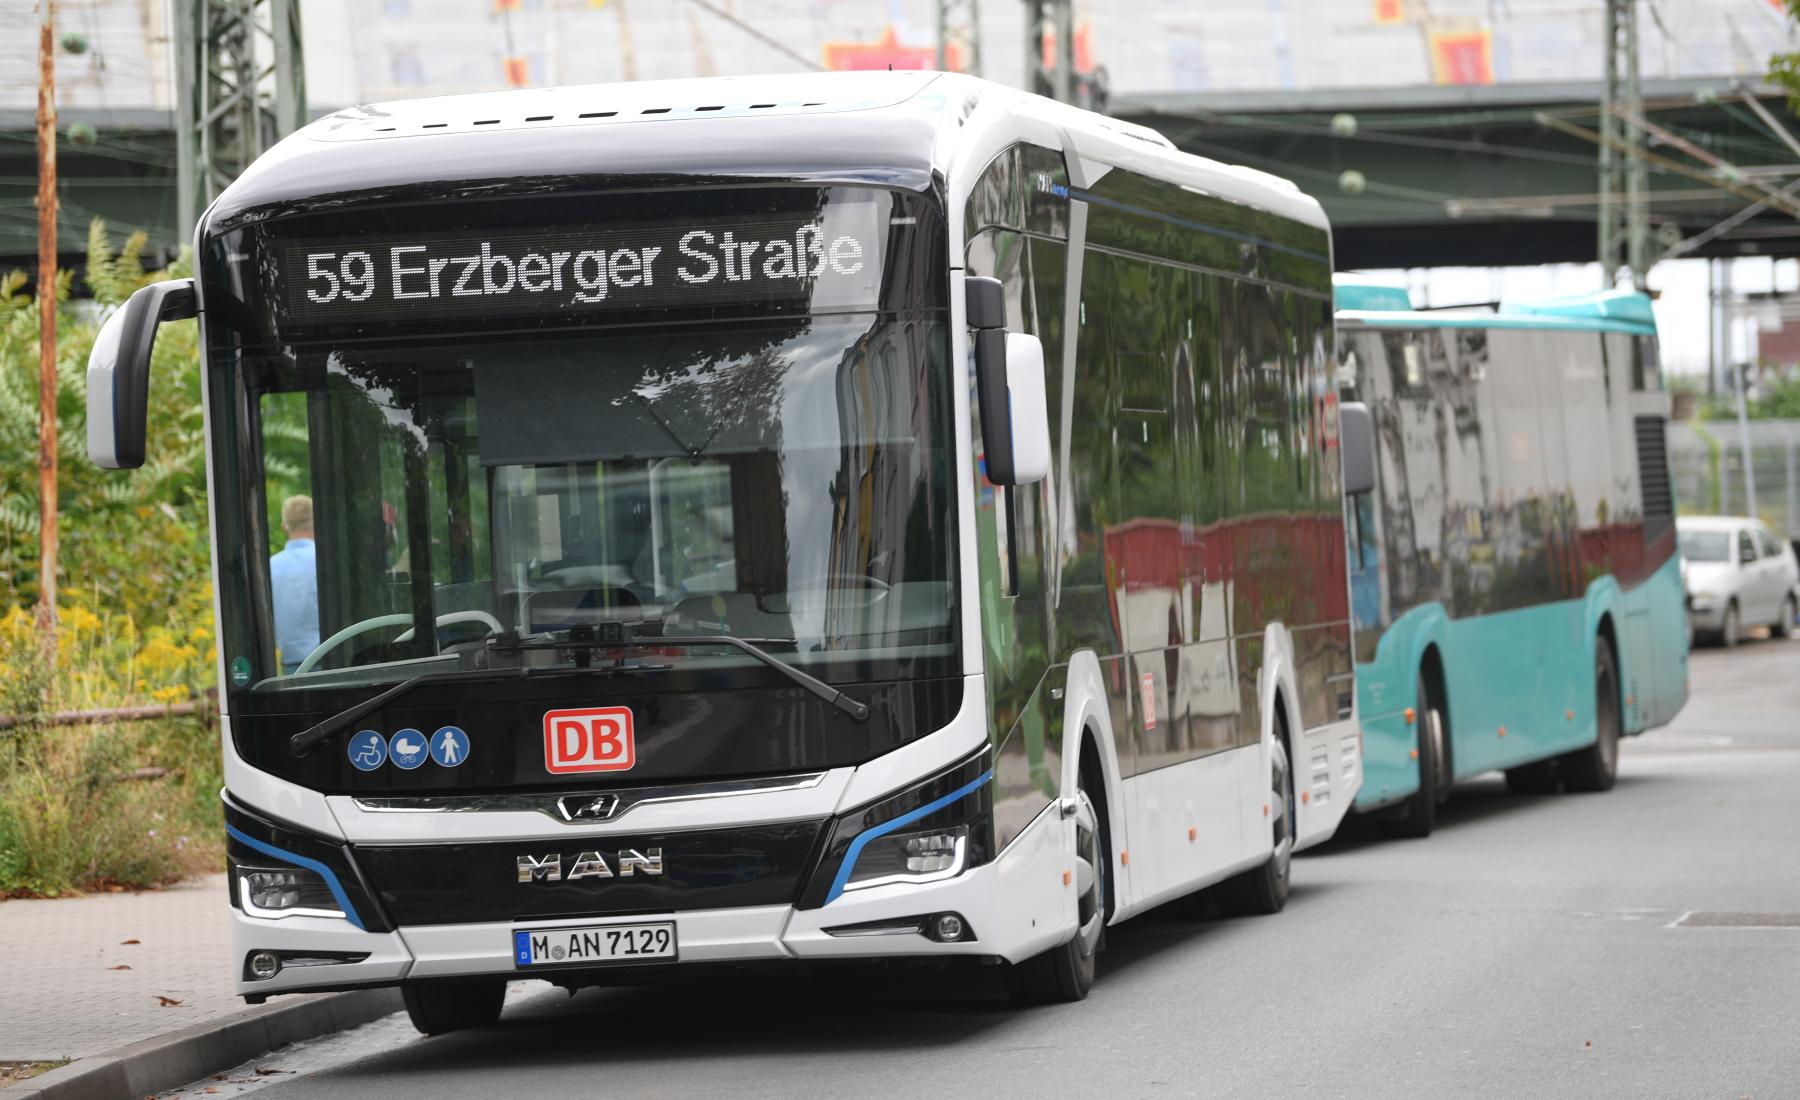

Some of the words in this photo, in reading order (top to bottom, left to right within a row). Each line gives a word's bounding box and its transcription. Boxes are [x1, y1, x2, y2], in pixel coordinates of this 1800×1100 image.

[308, 251, 375, 303] 59
[391, 242, 662, 303] Erzberger
[677, 224, 863, 284] Straße
[556, 719, 623, 762] DB
[517, 847, 663, 882] MAN
[532, 935, 549, 960] M
[568, 932, 600, 958] AN
[606, 929, 670, 955] 7129
